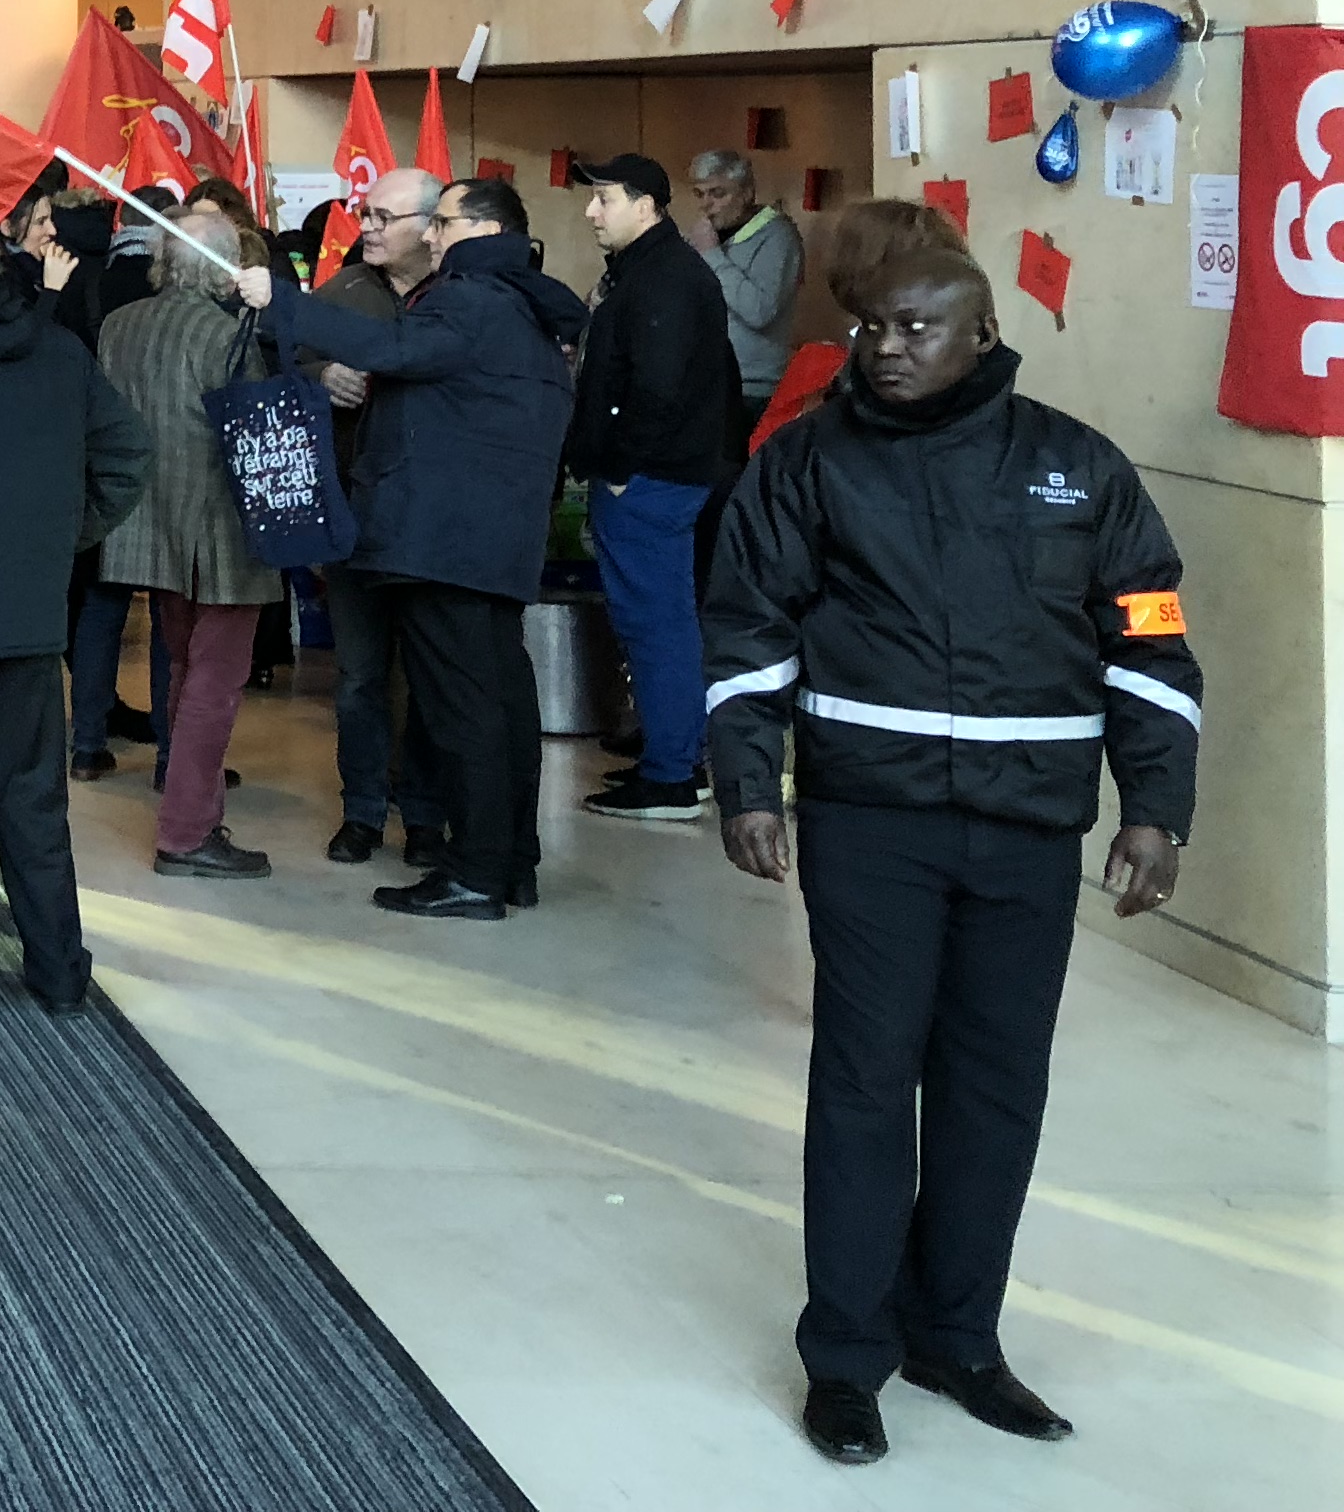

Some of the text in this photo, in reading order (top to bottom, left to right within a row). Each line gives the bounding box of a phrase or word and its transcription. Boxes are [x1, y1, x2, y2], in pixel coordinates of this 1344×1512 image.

[243, 475, 274, 498] sur
[1029, 485, 1089, 500] FIDUCIAL
[265, 488, 314, 510] terre
[1159, 603, 1180, 622] SE
